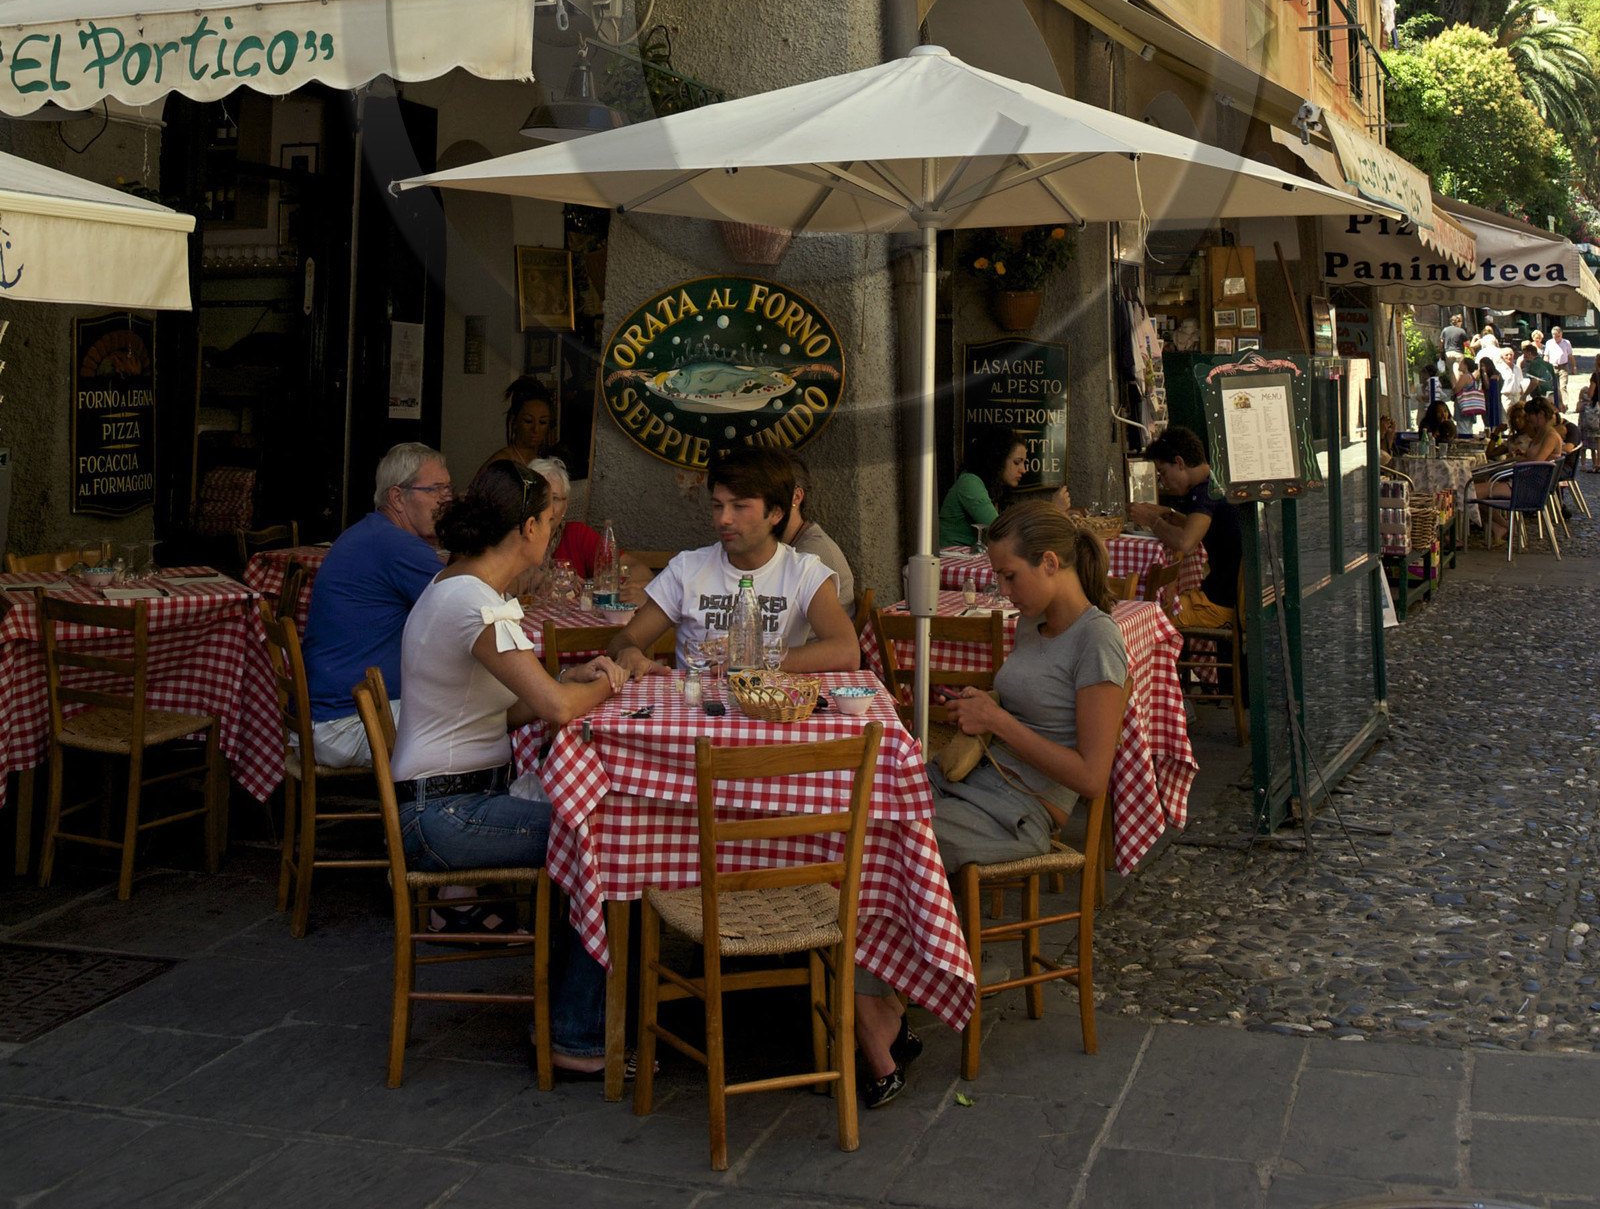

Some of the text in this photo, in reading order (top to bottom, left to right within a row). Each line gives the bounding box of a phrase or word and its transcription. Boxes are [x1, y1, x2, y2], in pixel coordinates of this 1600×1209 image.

[1324, 251, 1568, 283] Paninoteca
[613, 283, 832, 368] ORATA AL FORNO
[973, 359, 1045, 375] LASAGNE
[991, 379, 1063, 394] AL PESTO
[78, 390, 119, 409] FORNO
[128, 390, 154, 407] LEGNA
[1261, 392, 1282, 401] MENU
[967, 408, 1067, 425] MINESTRONE
[102, 421, 141, 440] PIZZA
[612, 387, 712, 468] SEPPIE
[79, 452, 138, 474] FOCACCIA
[79, 473, 153, 496] AL FORMAGGIO
